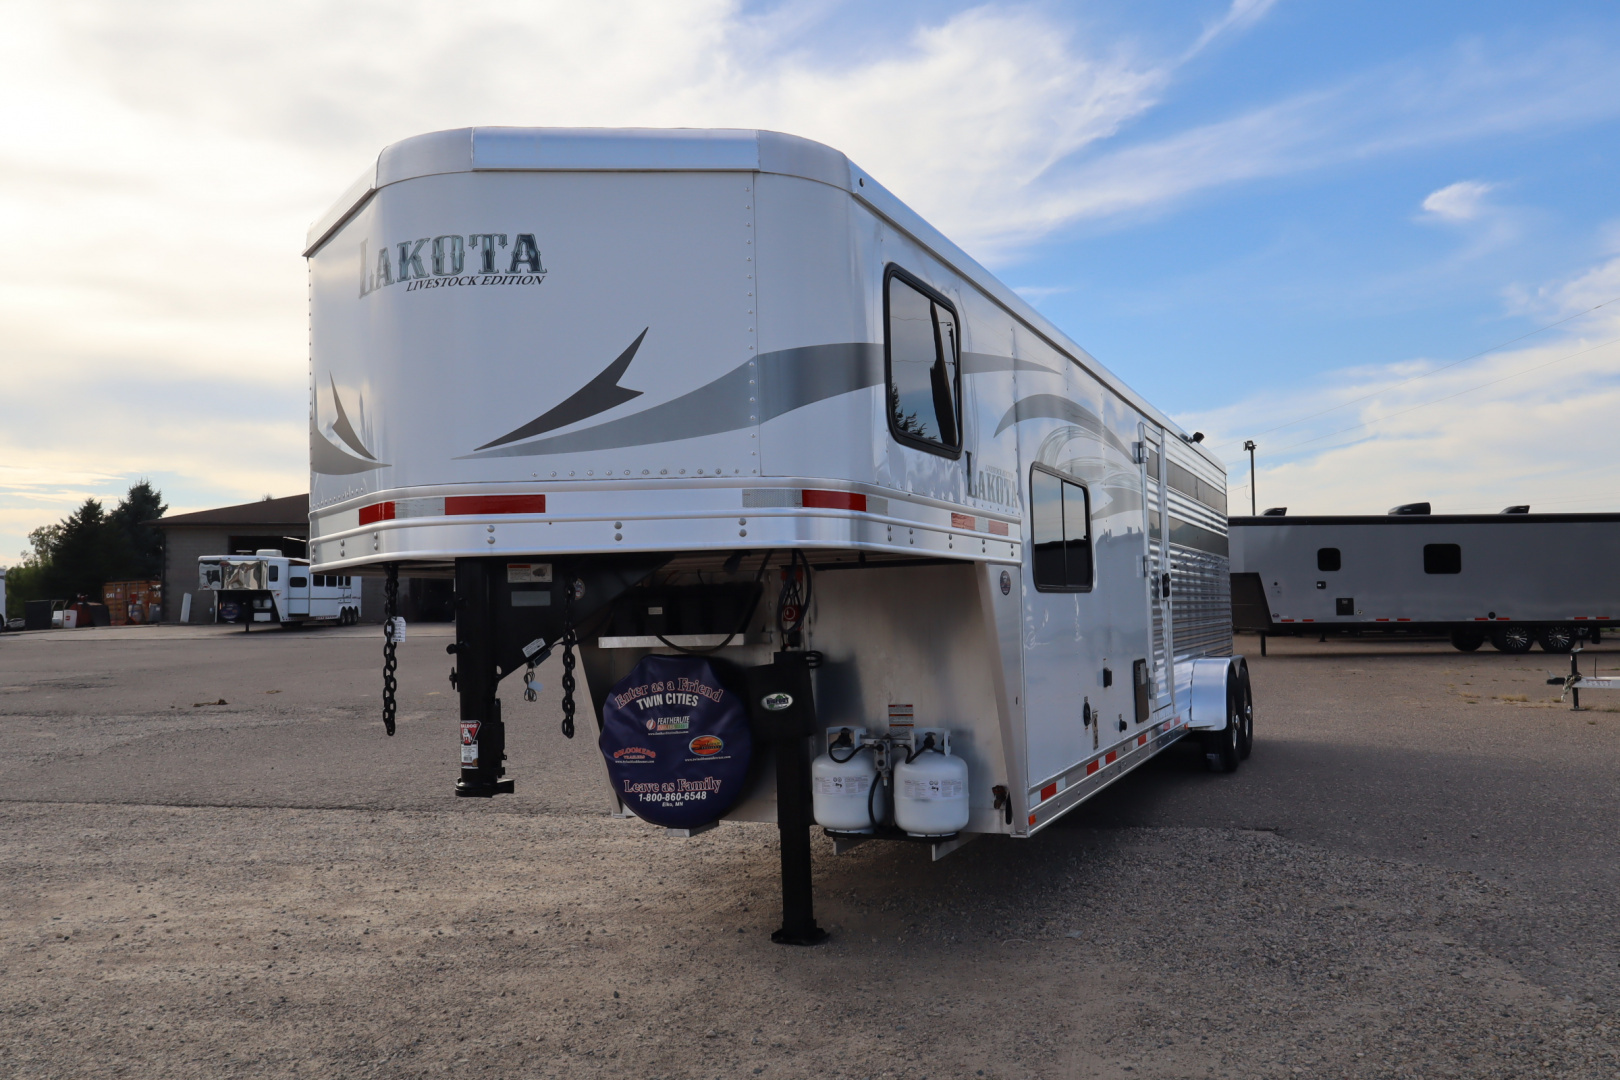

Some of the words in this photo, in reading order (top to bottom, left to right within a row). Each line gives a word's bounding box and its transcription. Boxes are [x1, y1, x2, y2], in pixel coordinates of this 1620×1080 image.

[358, 233, 547, 300] LAKOTA
[406, 275, 479, 292] LIVESTOCK
[481, 275, 546, 286] EDITION
[965, 450, 1018, 508] LAKOTA
[615, 686, 648, 709] Enter
[651, 681, 665, 692] as
[667, 682, 675, 691] a
[678, 678, 723, 702] Friend
[636, 693, 663, 711] TWIN
[667, 692, 699, 707] CITIES
[657, 716, 690, 725] FEATHERLITE
[624, 779, 660, 793] Leave
[661, 781, 675, 792] as
[677, 776, 722, 793] Family
[638, 791, 707, 802] 1-800-860-6548
